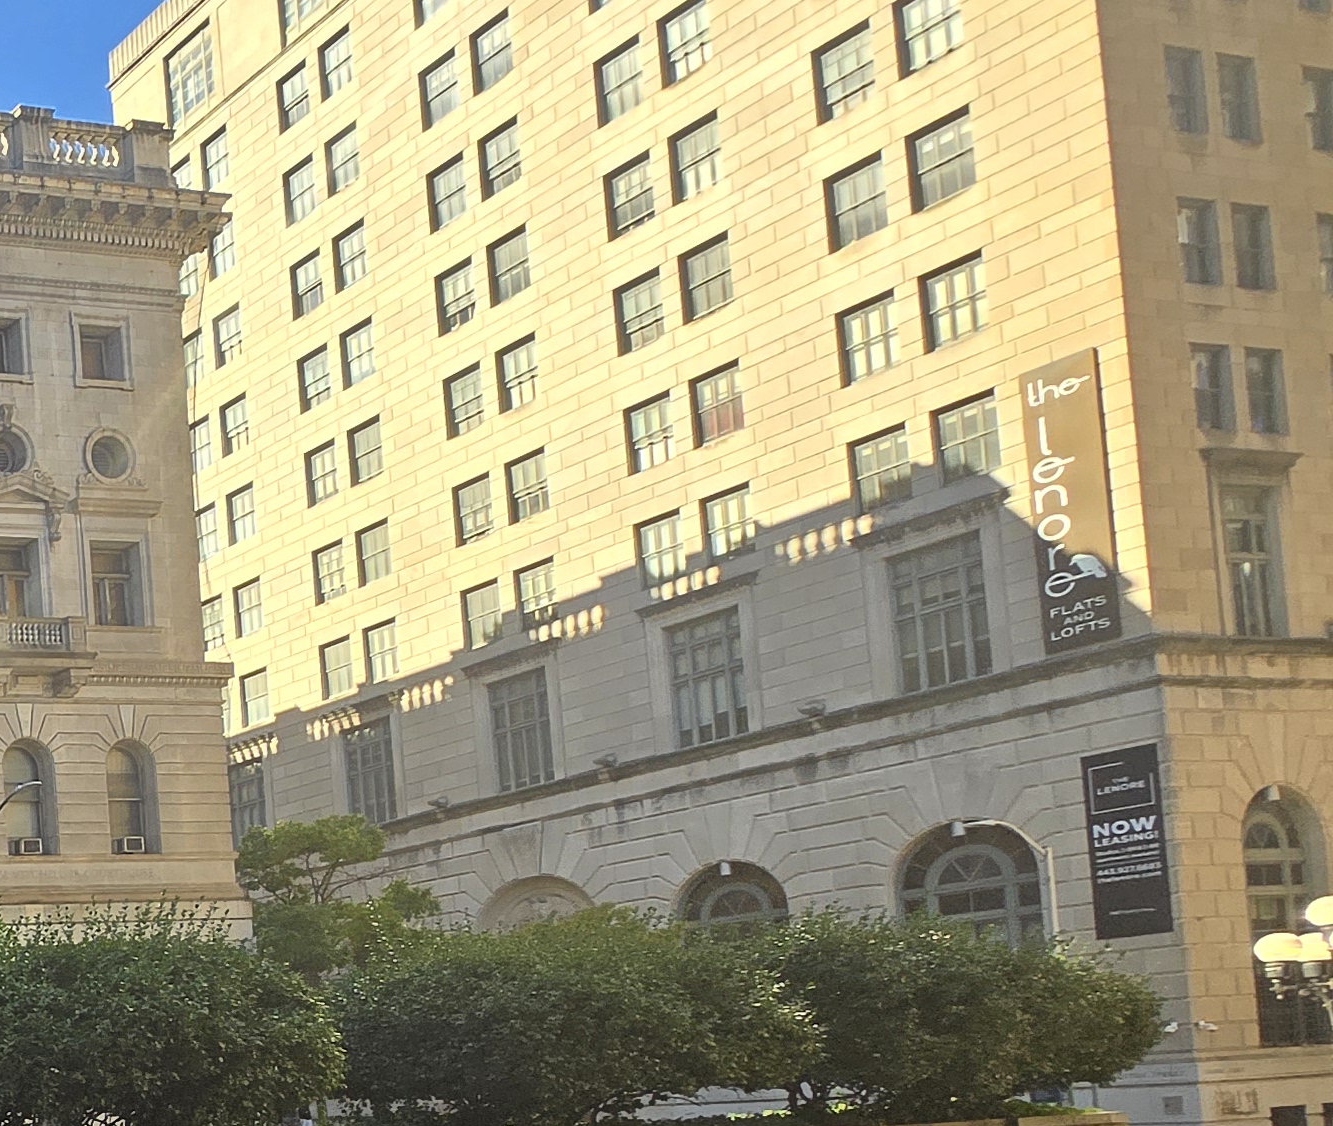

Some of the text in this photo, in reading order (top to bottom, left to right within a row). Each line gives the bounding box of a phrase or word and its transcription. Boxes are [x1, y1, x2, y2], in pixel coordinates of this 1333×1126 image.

[1027, 375, 1090, 407] the
[1033, 416, 1079, 597] lenore
[1050, 595, 1107, 619] FLATS
[1063, 611, 1095, 625] AND
[1050, 617, 1111, 641] LOFTS
[1096, 780, 1146, 795] LENORE
[1093, 815, 1157, 838] NOW
[1094, 830, 1159, 848] LEASING!
